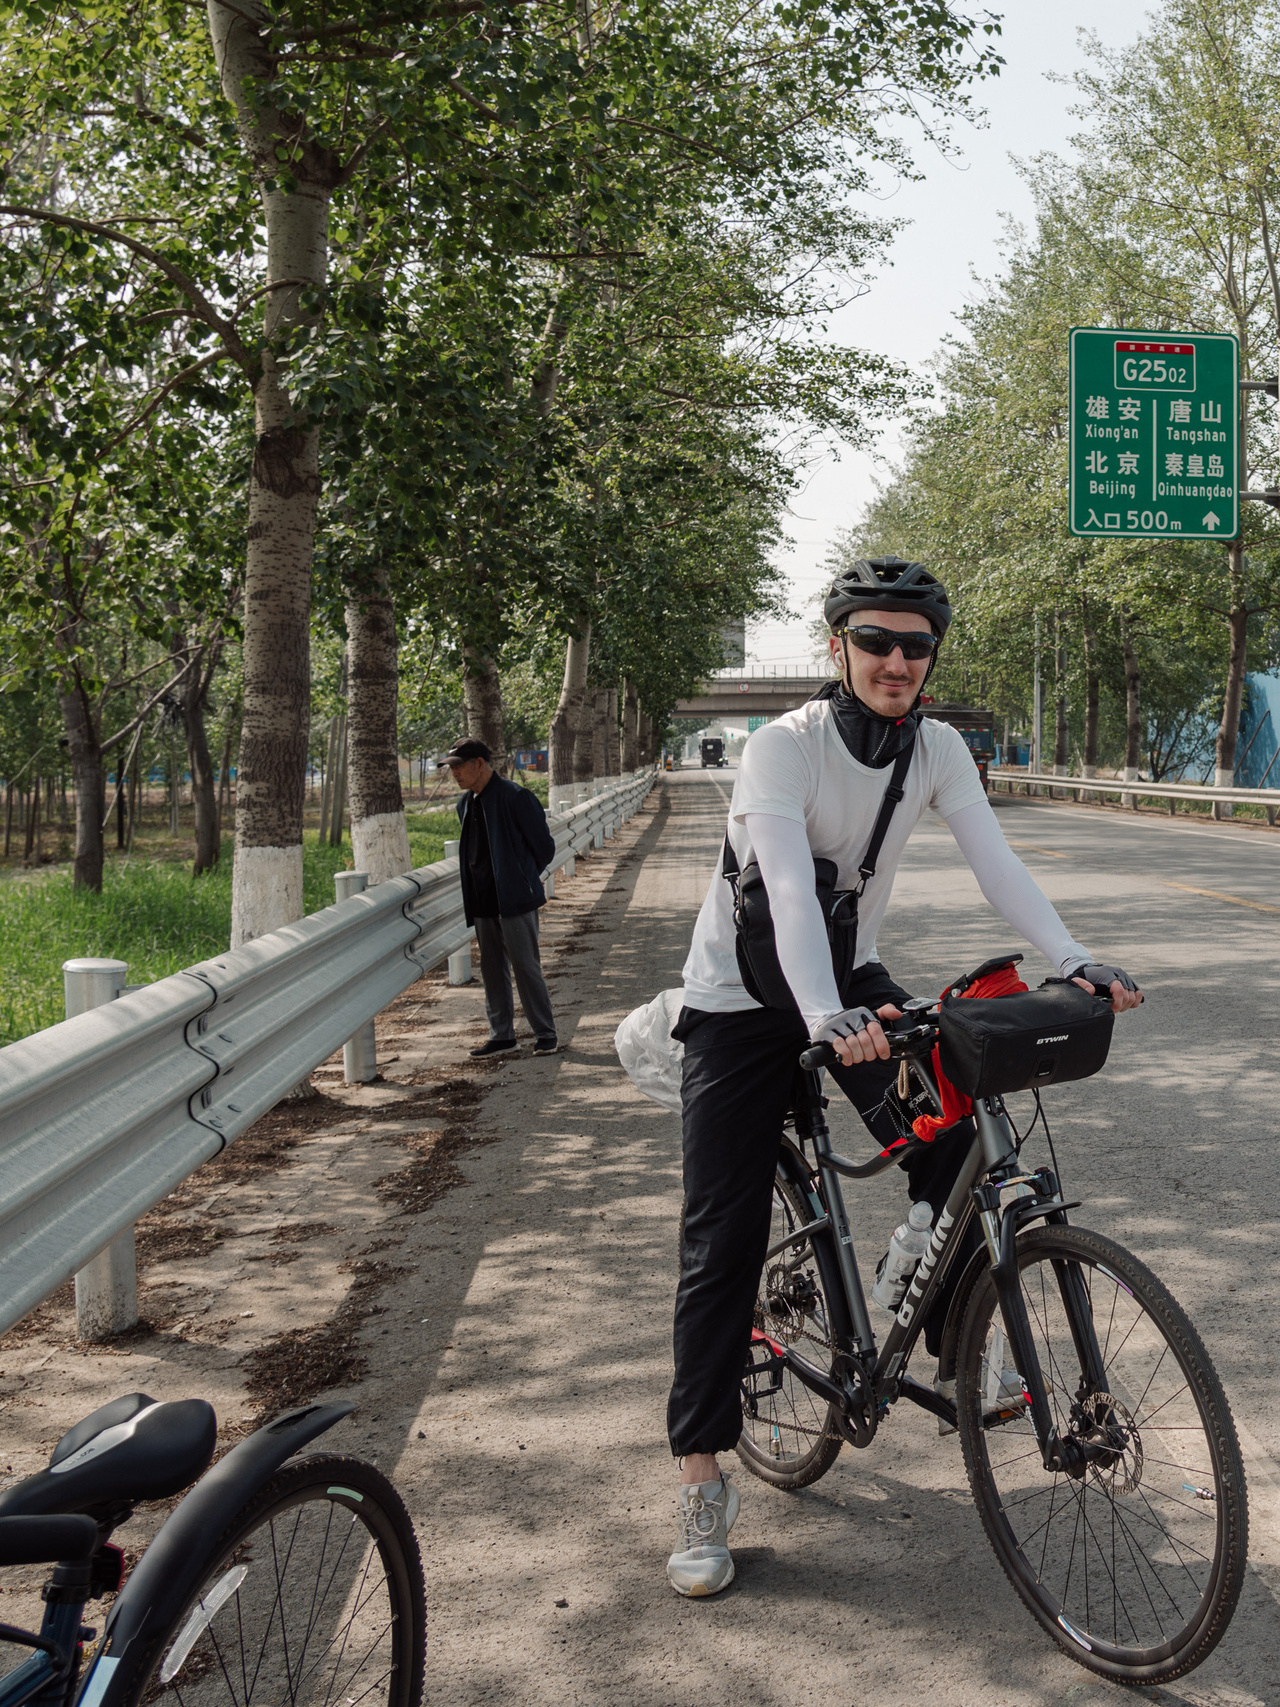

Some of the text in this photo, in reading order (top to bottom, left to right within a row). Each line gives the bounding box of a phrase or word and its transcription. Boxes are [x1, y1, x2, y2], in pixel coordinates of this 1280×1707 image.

[1123, 358, 1187, 384] G2502
[1085, 395, 1142, 421] 雄安
[1168, 399, 1222, 423] 唐山
[1085, 424, 1139, 442] Xiong'an
[1166, 426, 1227, 445] Tangshan
[1085, 450, 1140, 475] 北京
[1165, 452, 1225, 478] 秦皇岛
[1089, 480, 1136, 499] Beijing
[1158, 481, 1233, 501] Qinhuangdao
